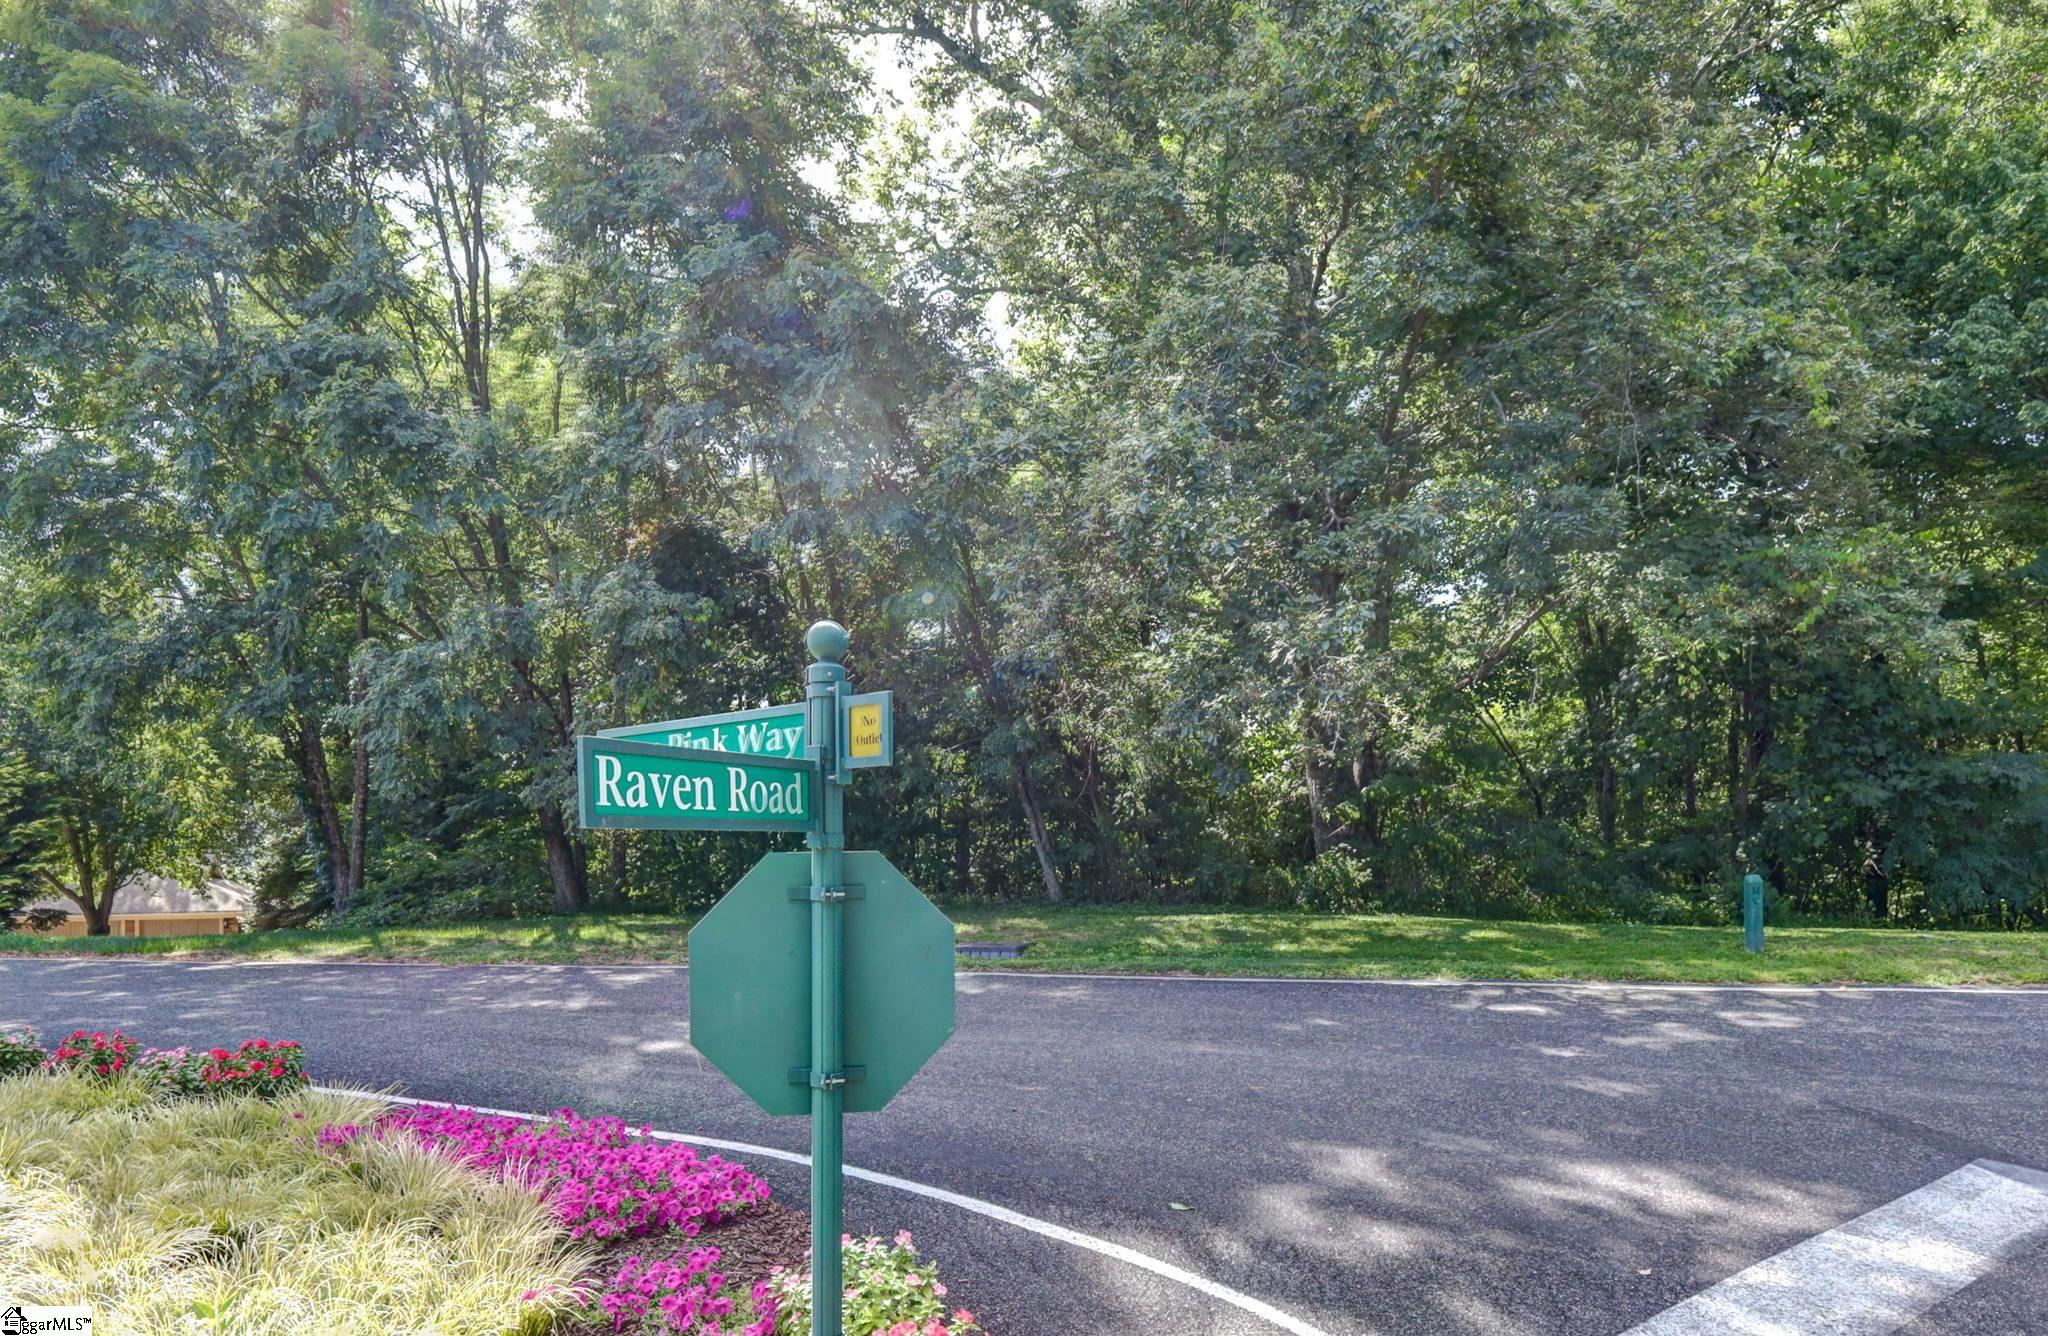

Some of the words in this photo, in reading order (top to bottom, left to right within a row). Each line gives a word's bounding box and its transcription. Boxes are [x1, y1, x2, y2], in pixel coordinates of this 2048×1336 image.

[860, 714, 877, 727] No
[736, 722, 804, 759] Way
[854, 733, 883, 746] Outlet
[594, 754, 717, 811] Raven
[726, 766, 804, 815] Road
